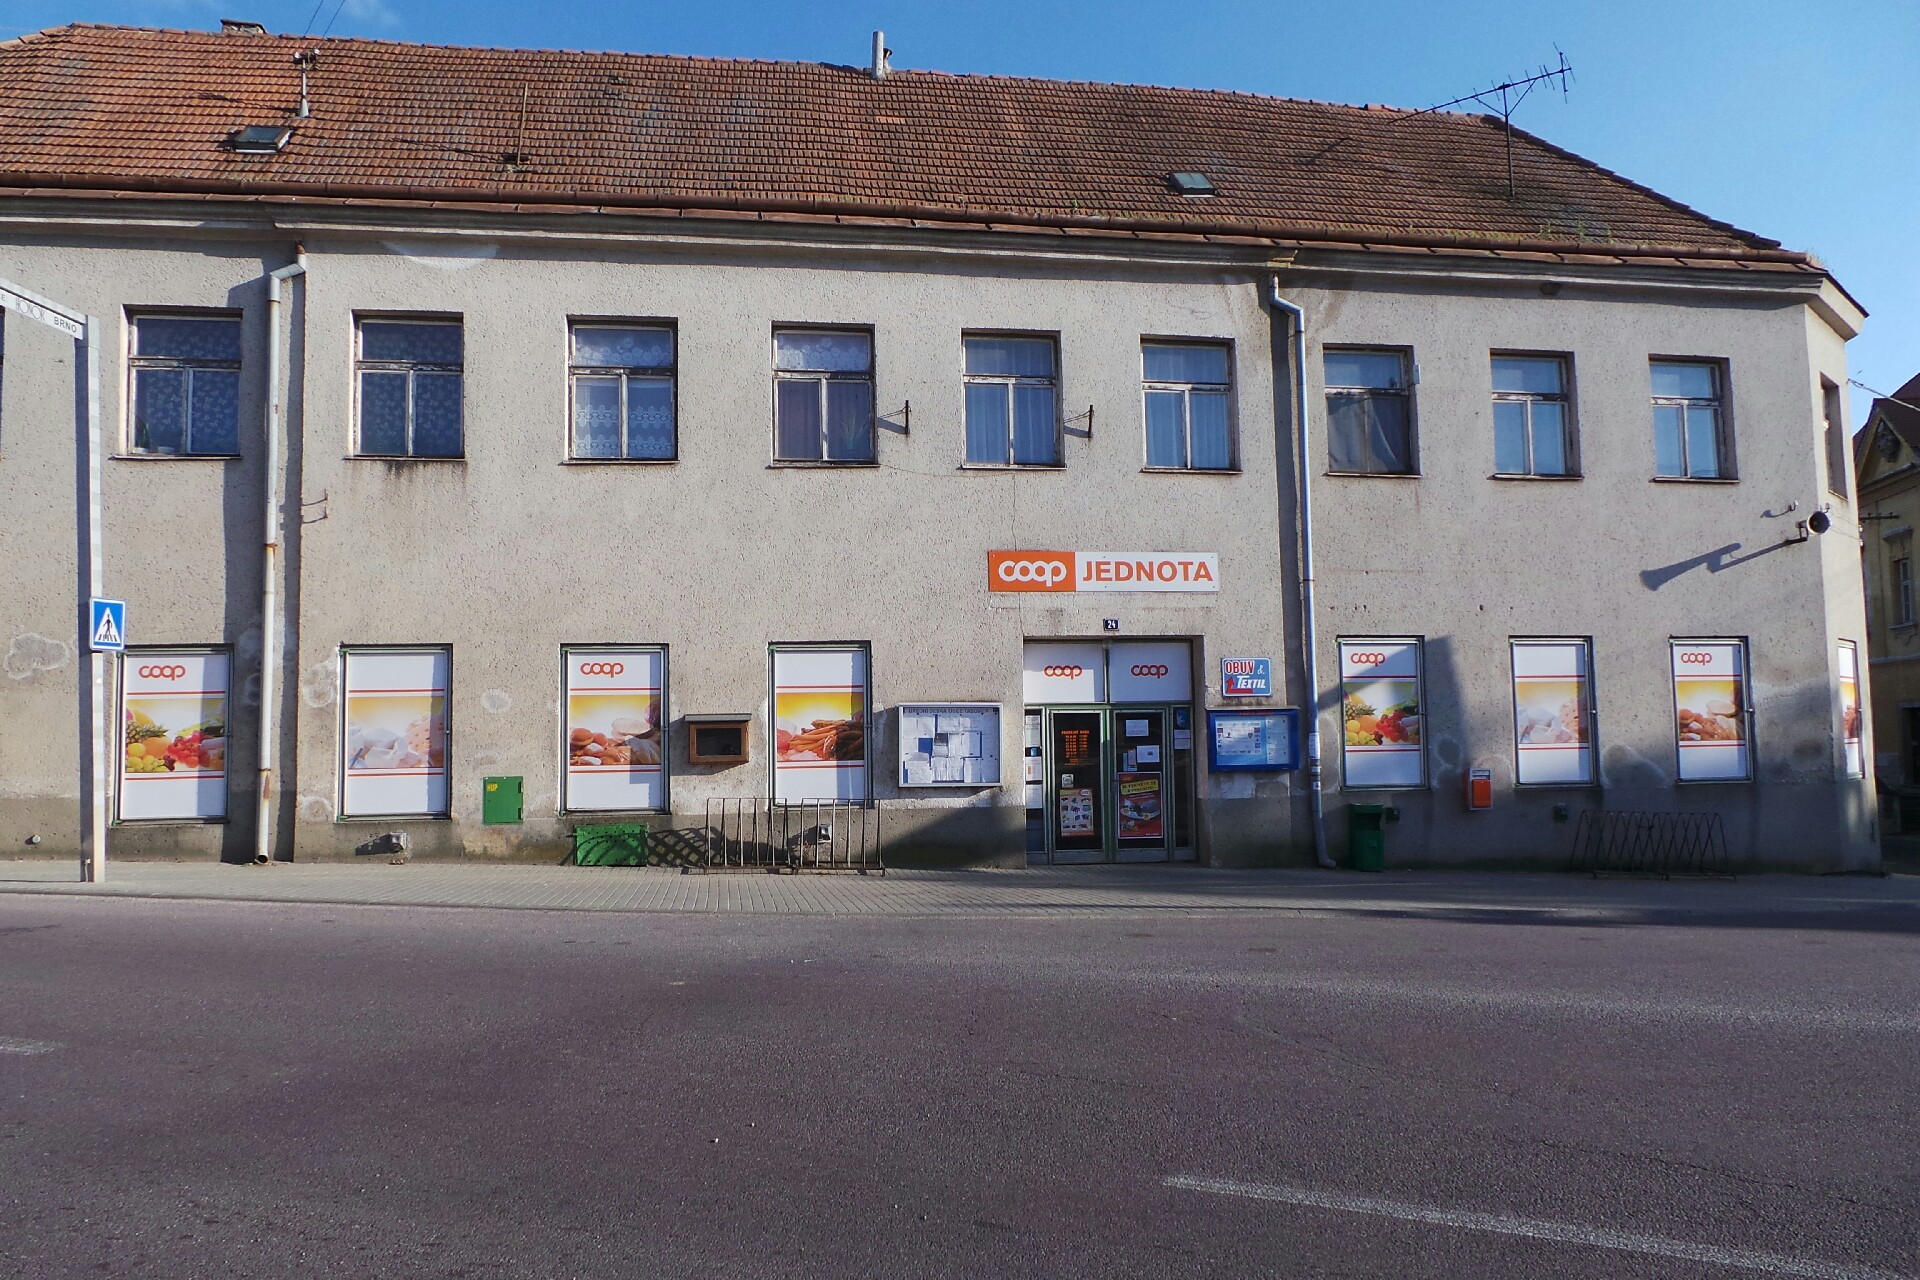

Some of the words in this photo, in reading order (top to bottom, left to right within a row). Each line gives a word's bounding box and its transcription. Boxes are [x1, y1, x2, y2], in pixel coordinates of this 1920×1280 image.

[53, 316, 77, 333] BRNO
[998, 560, 1067, 587] coop
[1083, 561, 1214, 582] JEDNOTA
[1107, 620, 1116, 629] 24
[1350, 652, 1386, 667] coop
[1680, 652, 1712, 666] coop
[138, 665, 186, 680] coop
[581, 662, 624, 678] coop
[1043, 665, 1083, 680] coop
[1130, 664, 1169, 679] coop
[1225, 660, 1255, 674] OBUV
[1236, 675, 1266, 689] TEXTIL
